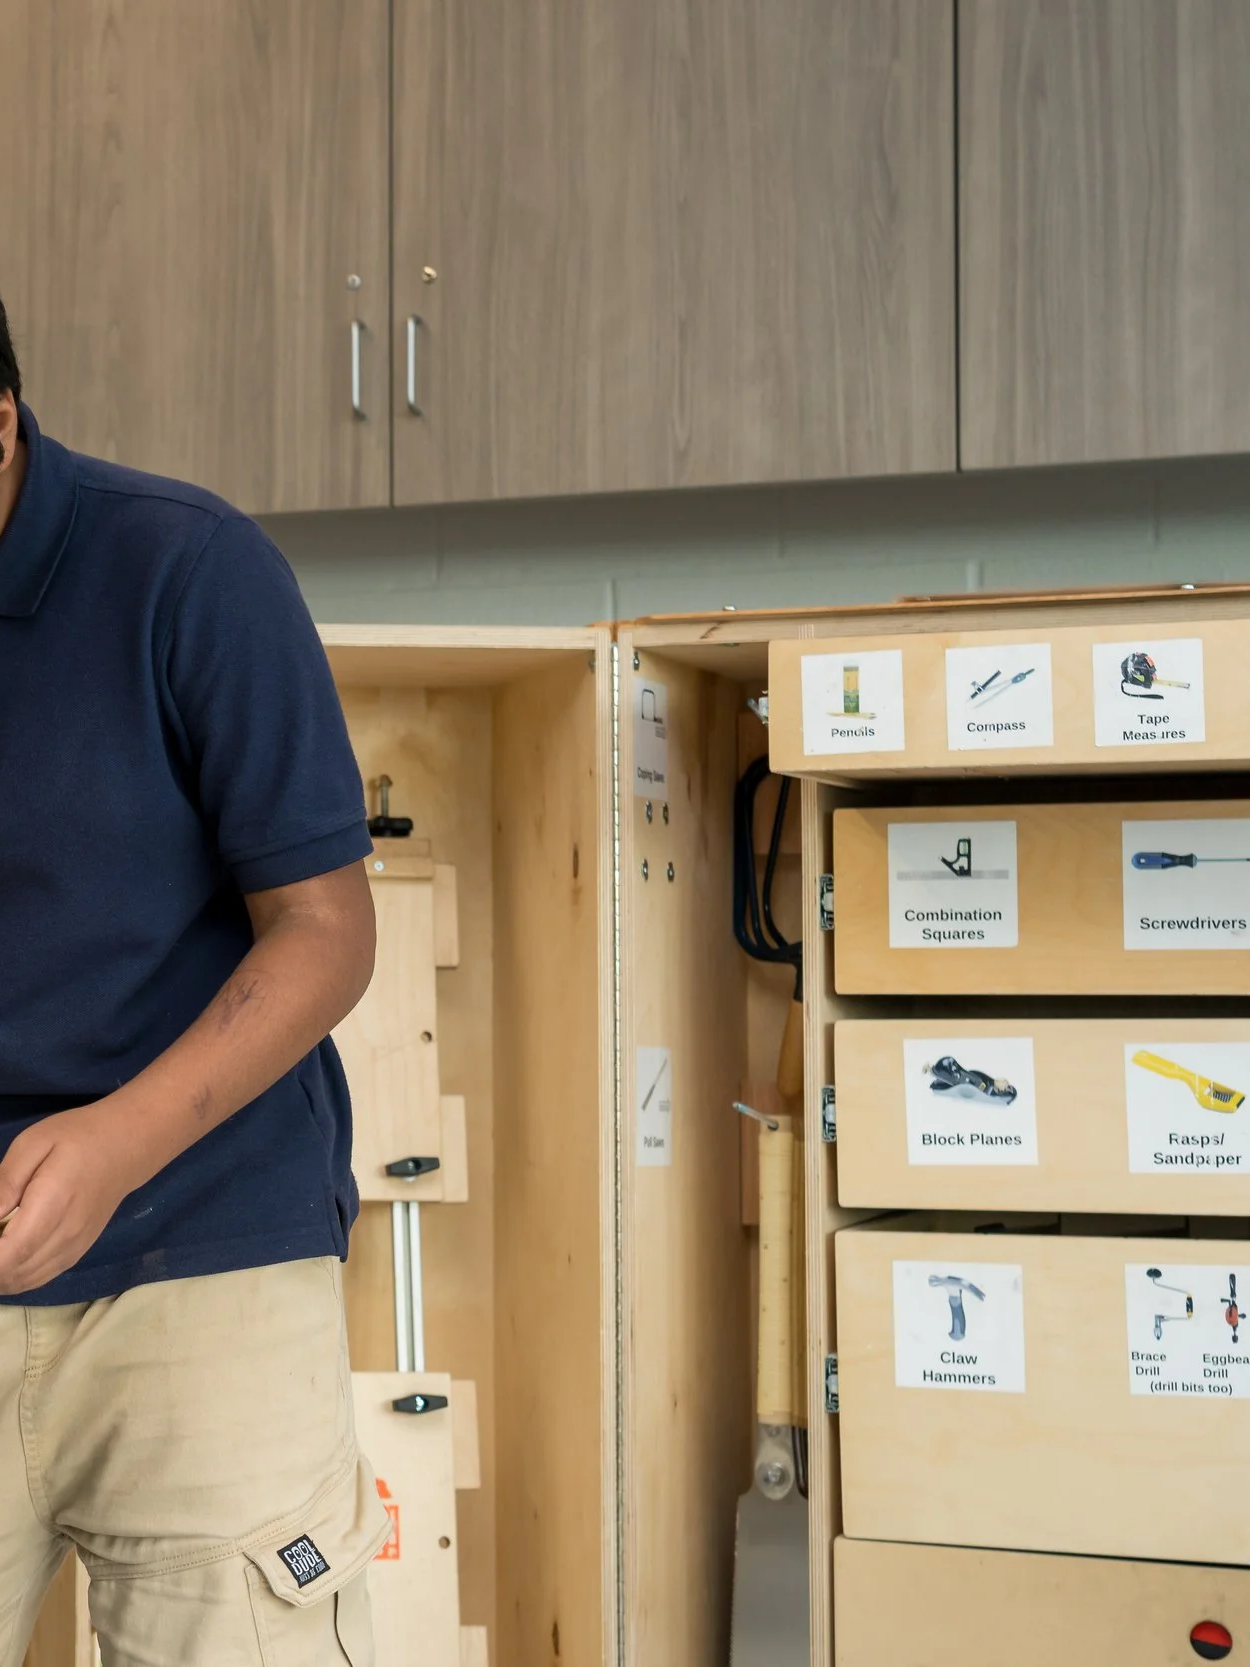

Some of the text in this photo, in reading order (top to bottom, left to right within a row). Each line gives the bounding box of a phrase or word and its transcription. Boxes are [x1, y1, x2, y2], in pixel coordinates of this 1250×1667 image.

[1137, 714, 1170, 726] Tape
[831, 726, 875, 738] Pencils
[967, 721, 1026, 734] Compass
[904, 908, 1002, 922] Combination
[1140, 917, 1247, 930] Screwdrivers
[922, 928, 985, 943] Squares
[922, 1133, 1022, 1145] Block Planes
[1169, 1132, 1225, 1148] Rasps/
[940, 1351, 978, 1365] Claw
[1131, 1351, 1167, 1361] Brace
[923, 1369, 996, 1386] Hammers
[1135, 1366, 1160, 1376] Drill
[1203, 1368, 1228, 1379] Drill
[1150, 1381, 1233, 1396] (drill bits too)
[283, 1539, 316, 1564] COOL
[291, 1550, 323, 1576] DUDE
